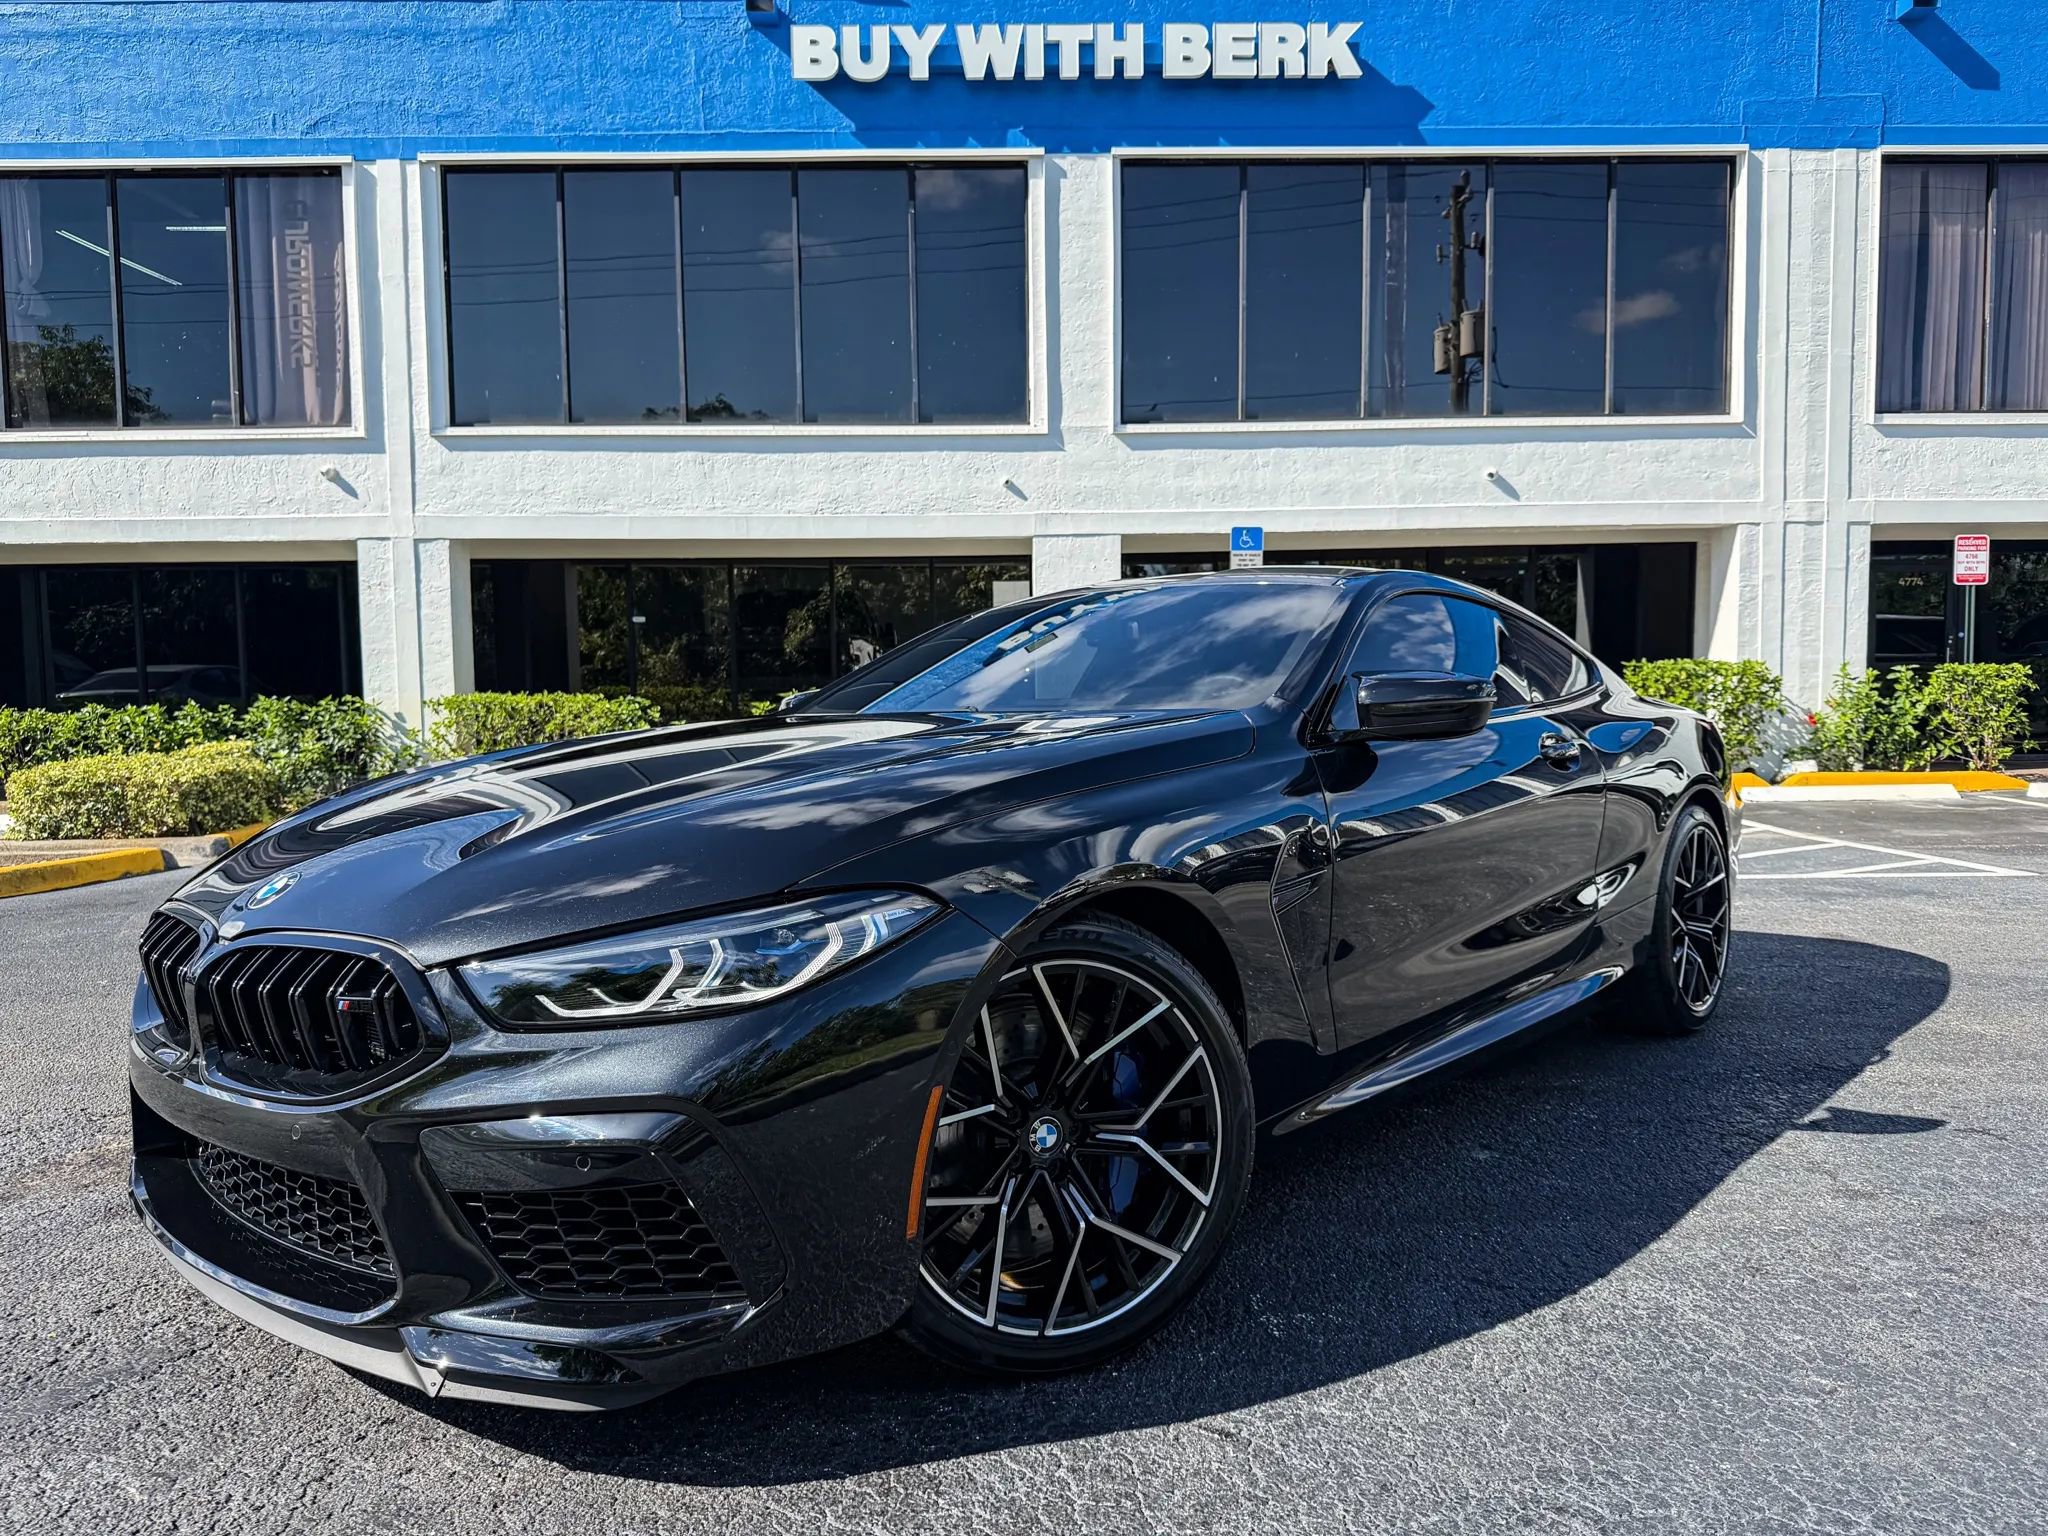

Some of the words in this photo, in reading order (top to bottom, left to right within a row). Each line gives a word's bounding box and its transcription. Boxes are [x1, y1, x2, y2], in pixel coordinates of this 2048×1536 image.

[790, 23, 946, 81] BUY
[955, 22, 1144, 81] WITH
[1162, 21, 1364, 80] BERK
[1898, 577, 1924, 586] 4774
